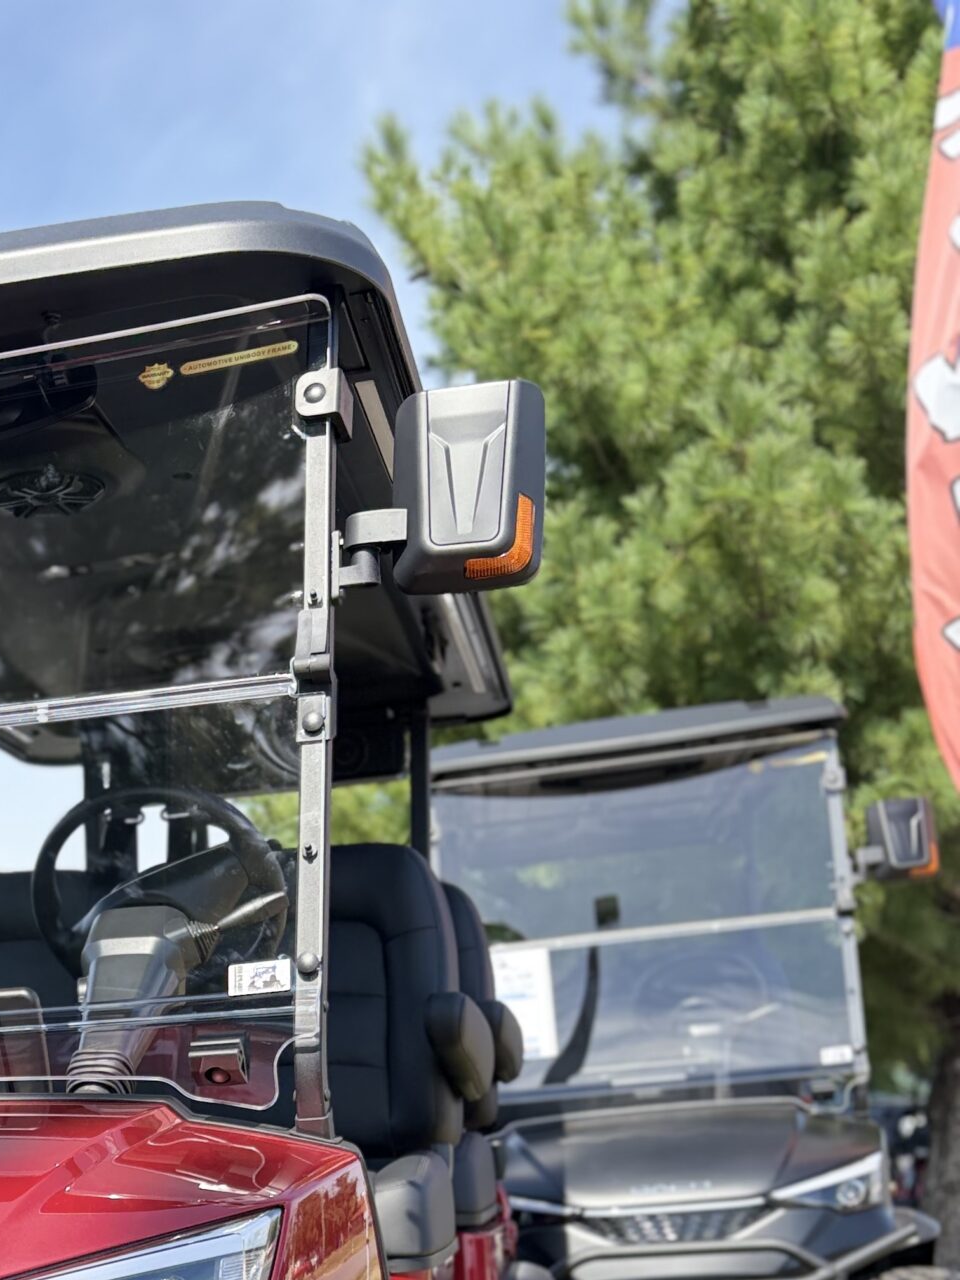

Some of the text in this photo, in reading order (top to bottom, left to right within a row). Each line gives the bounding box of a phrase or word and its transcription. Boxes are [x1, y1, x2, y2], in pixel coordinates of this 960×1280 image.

[188, 344, 291, 371] AUTOMOTIVE UNIBODY FRAME
